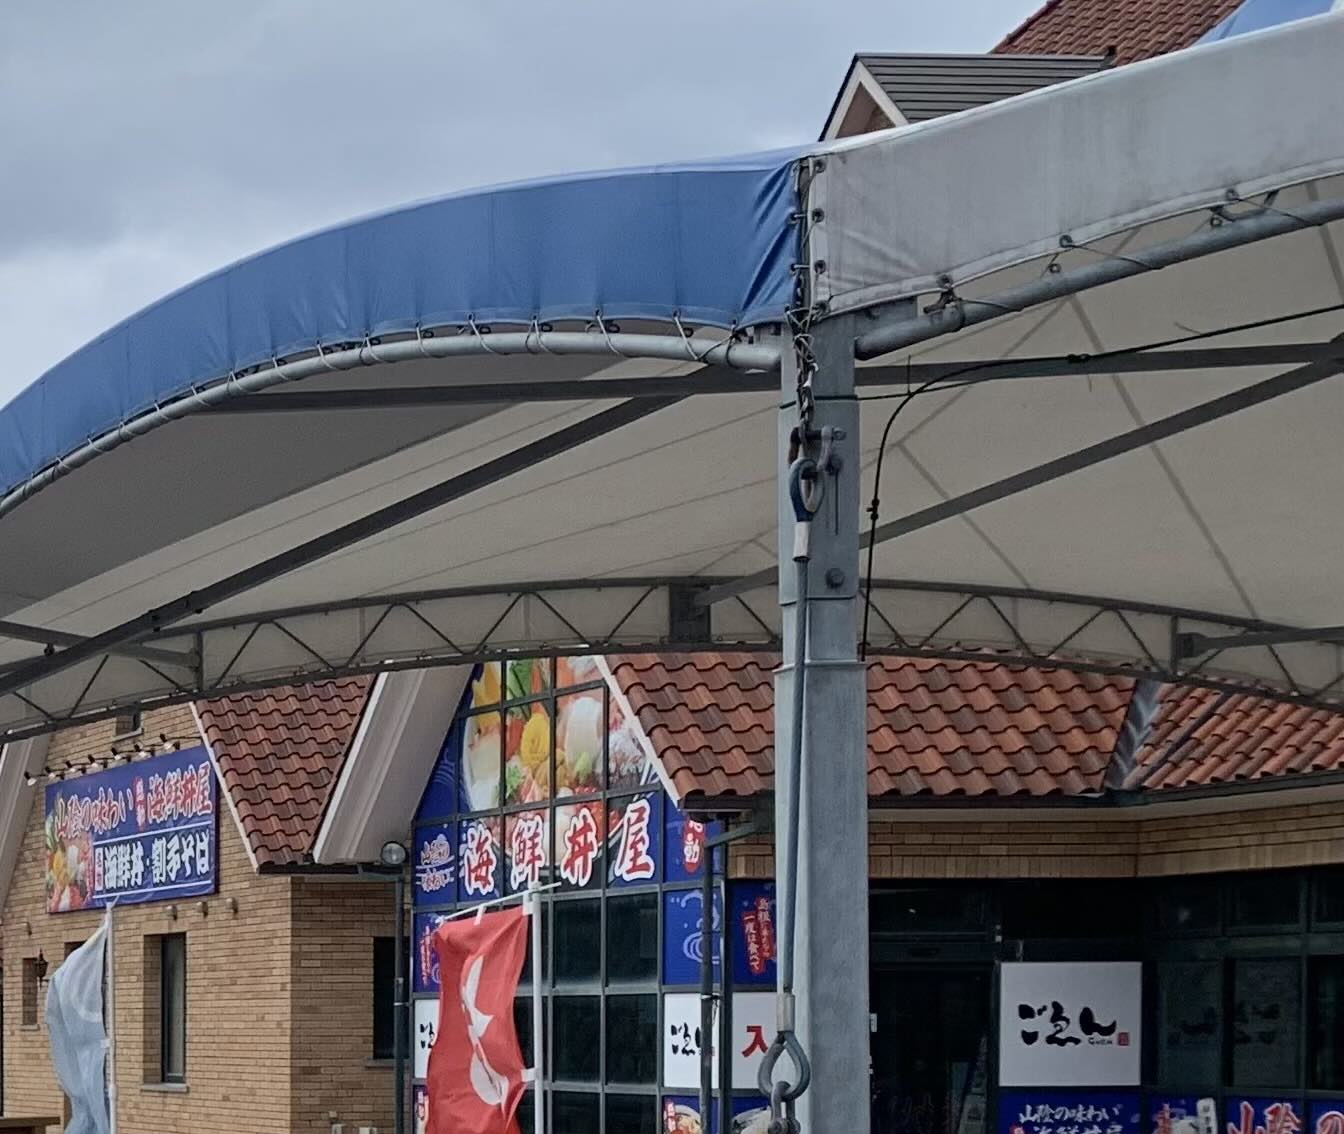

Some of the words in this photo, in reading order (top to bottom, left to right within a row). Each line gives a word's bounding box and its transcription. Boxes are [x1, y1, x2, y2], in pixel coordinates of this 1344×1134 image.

[464, 799, 655, 896] 海鮮丼屋
[1019, 1104, 1122, 1123] 山陰の味わい
